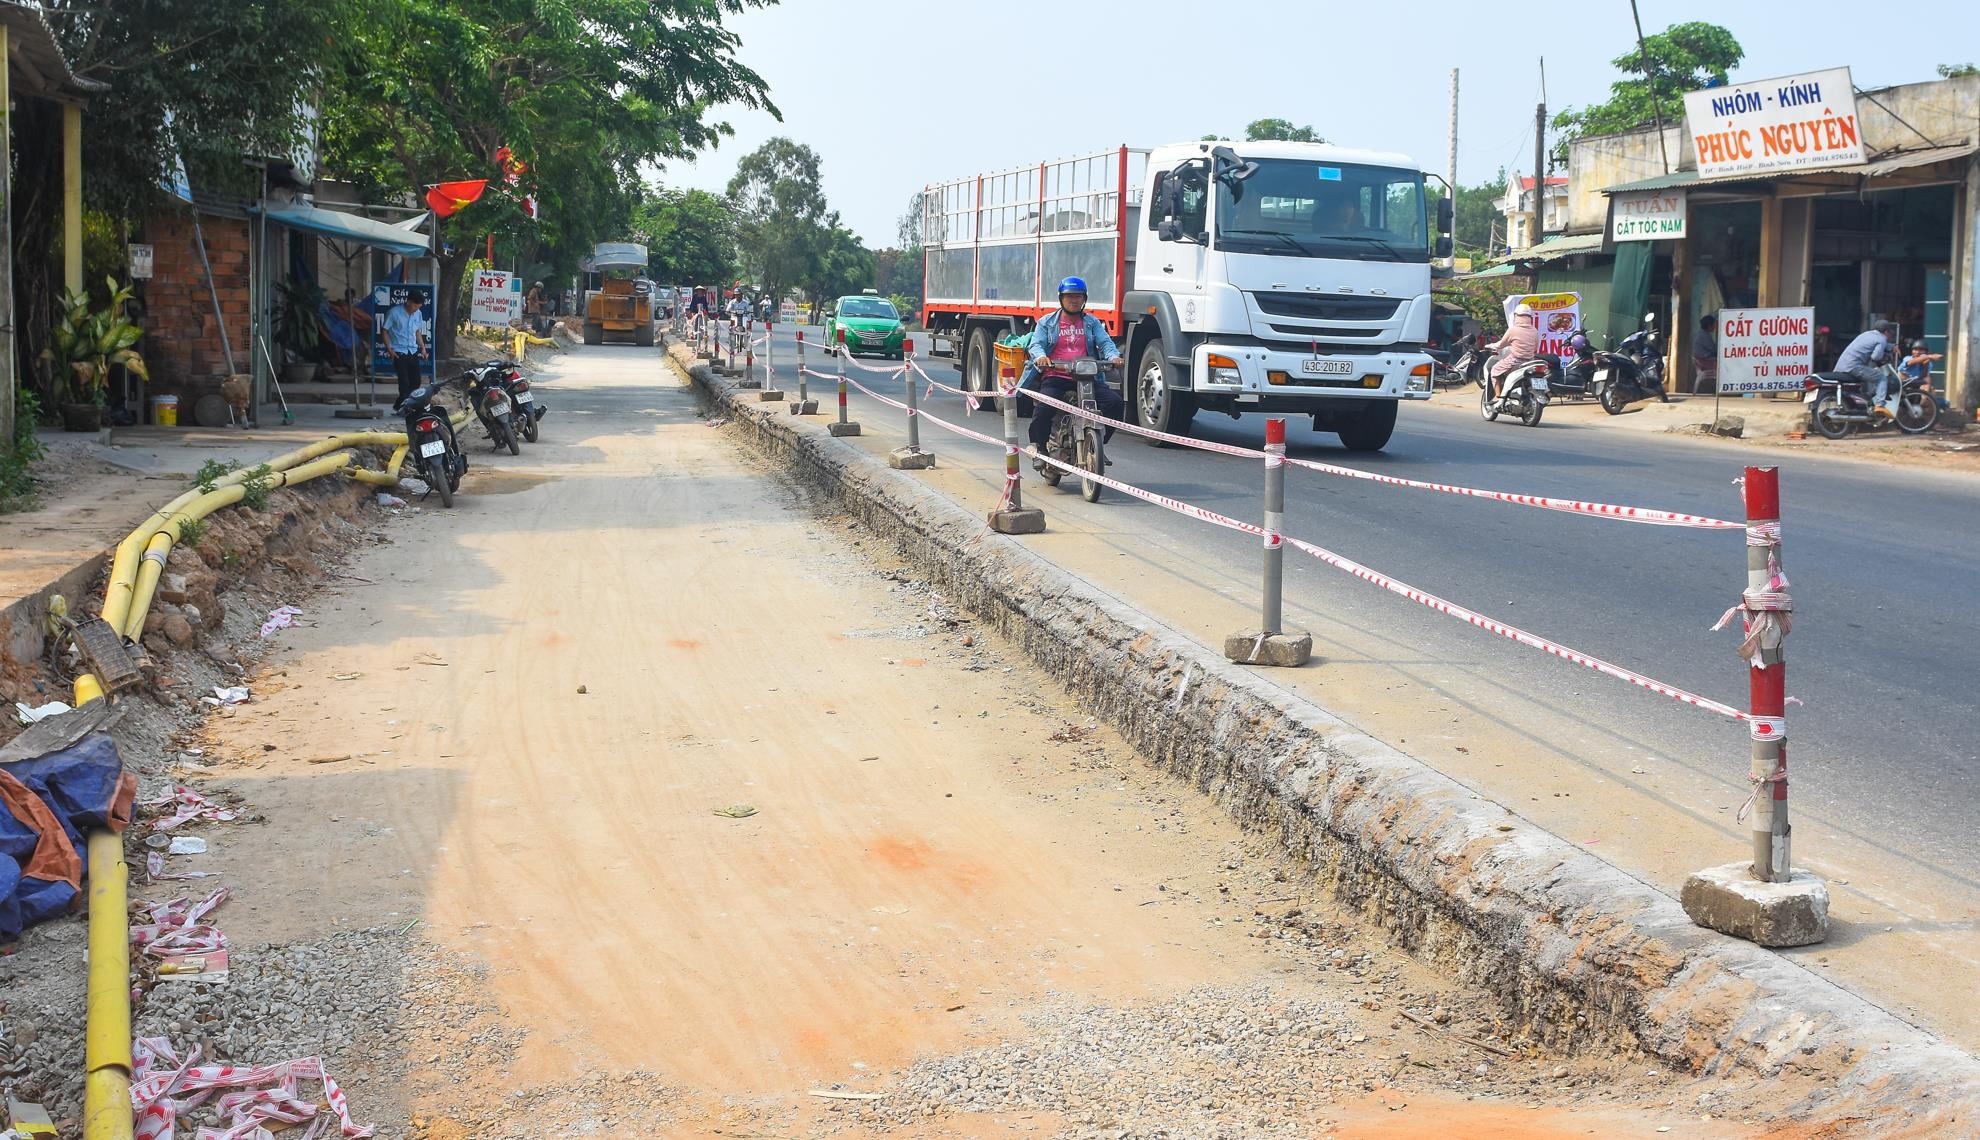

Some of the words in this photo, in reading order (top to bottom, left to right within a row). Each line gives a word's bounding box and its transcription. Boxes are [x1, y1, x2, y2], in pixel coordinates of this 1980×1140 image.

[1712, 88, 1762, 117] NHÔM
[1778, 80, 1822, 108] KÍNH
[1695, 121, 1753, 164] PHÚC
[1760, 107, 1858, 157] NGUYÊN
[1622, 190, 1678, 215] TUẤN
[1617, 216, 1636, 235] CẮT
[1638, 217, 1658, 234] TÓC
[1660, 218, 1682, 233] NAM
[1725, 312, 1753, 338] CẮT
[1759, 315, 1808, 336] GƯƠNG
[1776, 342, 1808, 357] NHÔM
[1753, 360, 1769, 377] TỦ
[1775, 361, 1809, 376] NHÔM
